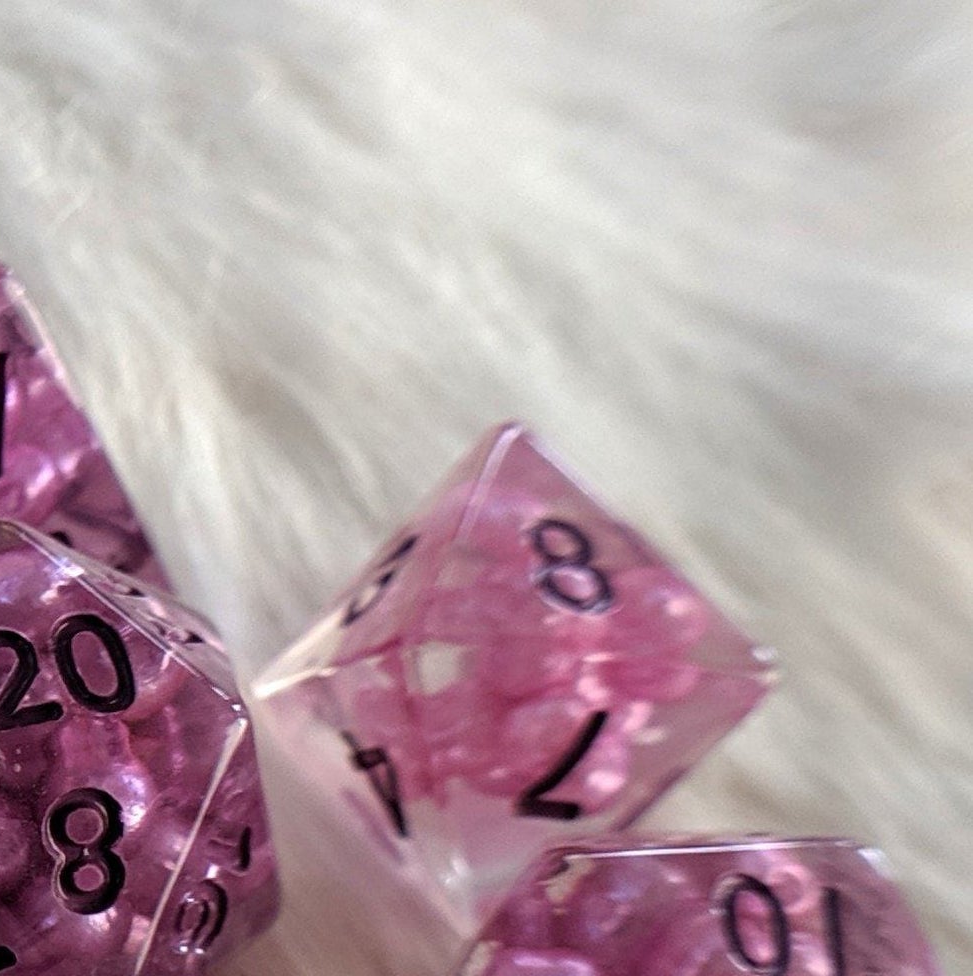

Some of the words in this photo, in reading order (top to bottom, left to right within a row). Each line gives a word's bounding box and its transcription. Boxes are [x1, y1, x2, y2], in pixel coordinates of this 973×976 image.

[532, 518, 612, 613] 8
[513, 710, 609, 821] 7
[43, 786, 125, 915] 8
